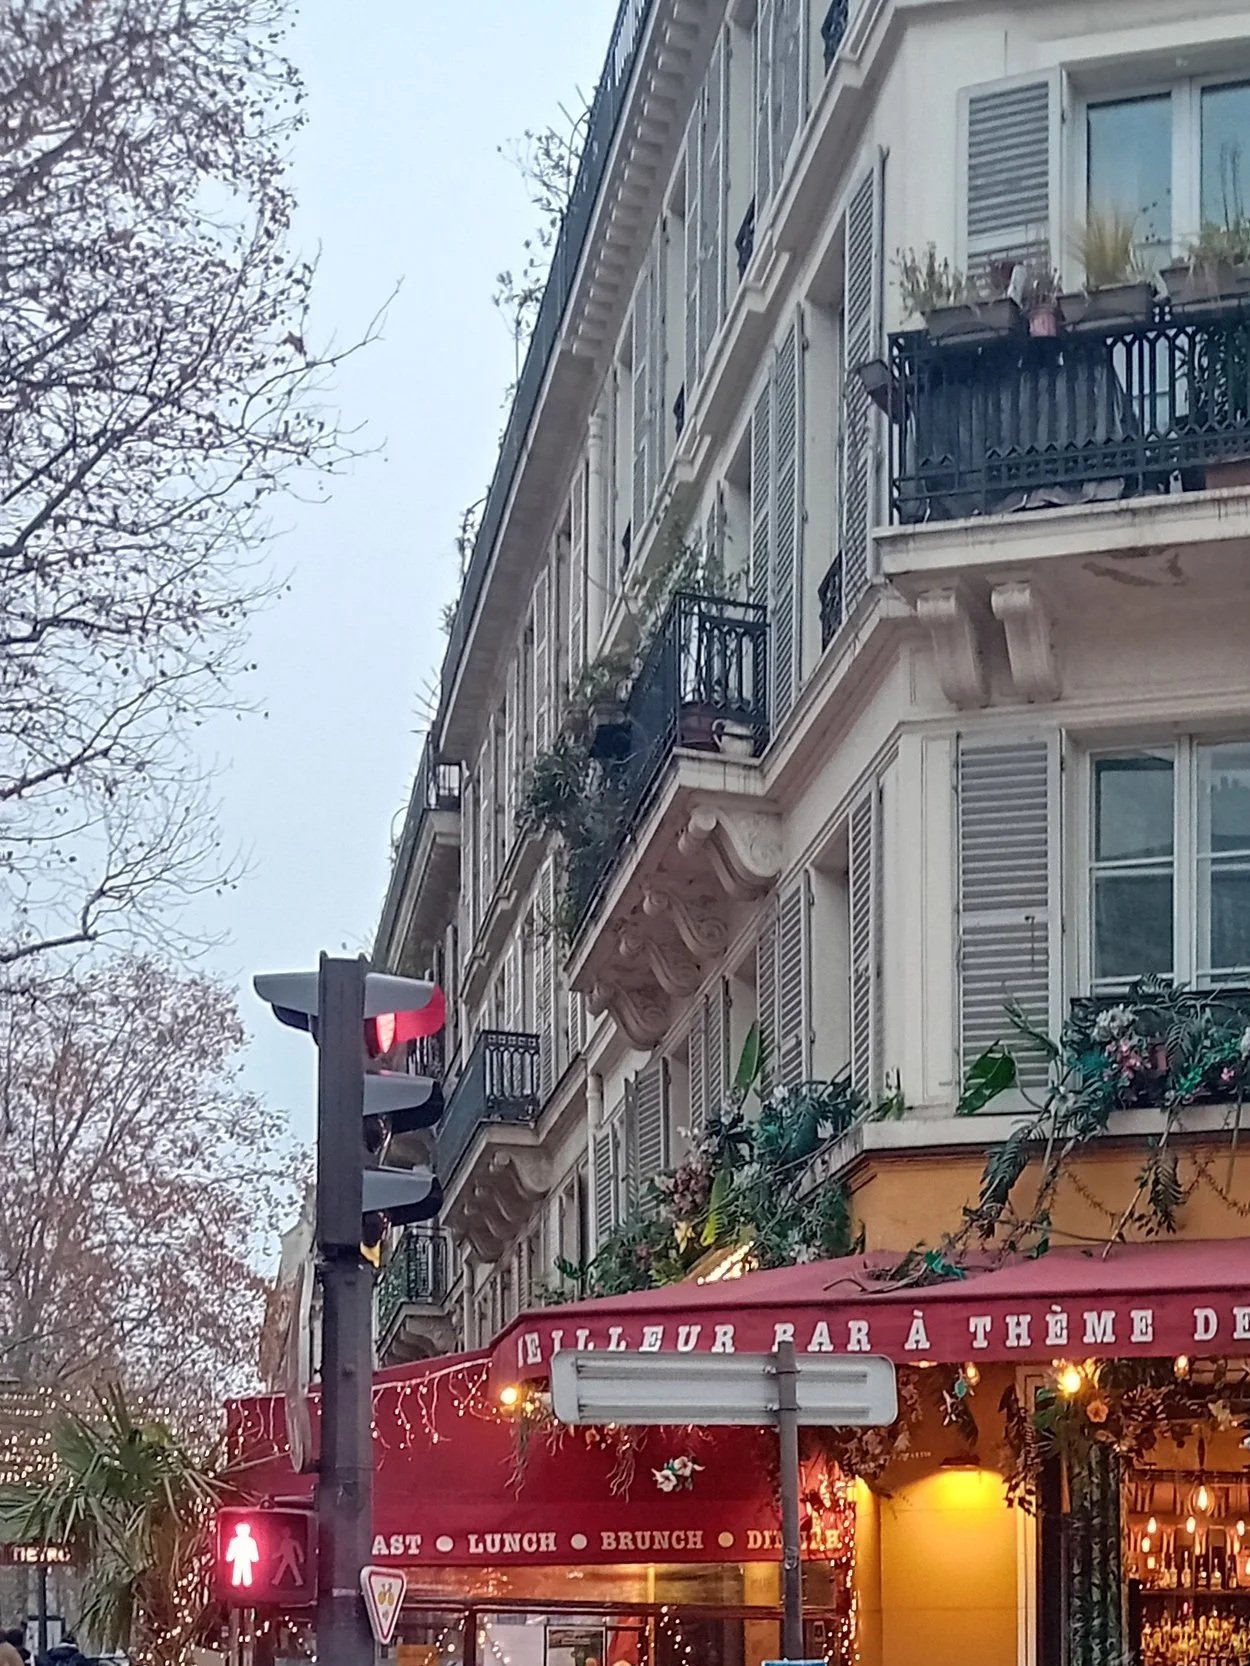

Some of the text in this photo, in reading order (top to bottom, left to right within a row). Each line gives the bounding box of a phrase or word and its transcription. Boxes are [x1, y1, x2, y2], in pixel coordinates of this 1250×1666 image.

[517, 1324, 735, 1369] EILLEUR
[772, 1319, 872, 1353] BAR
[903, 1309, 930, 1351] À
[968, 1304, 1155, 1350] THÈME
[468, 1531, 557, 1554] LUNCH
[600, 1530, 705, 1550] BRUNCH
